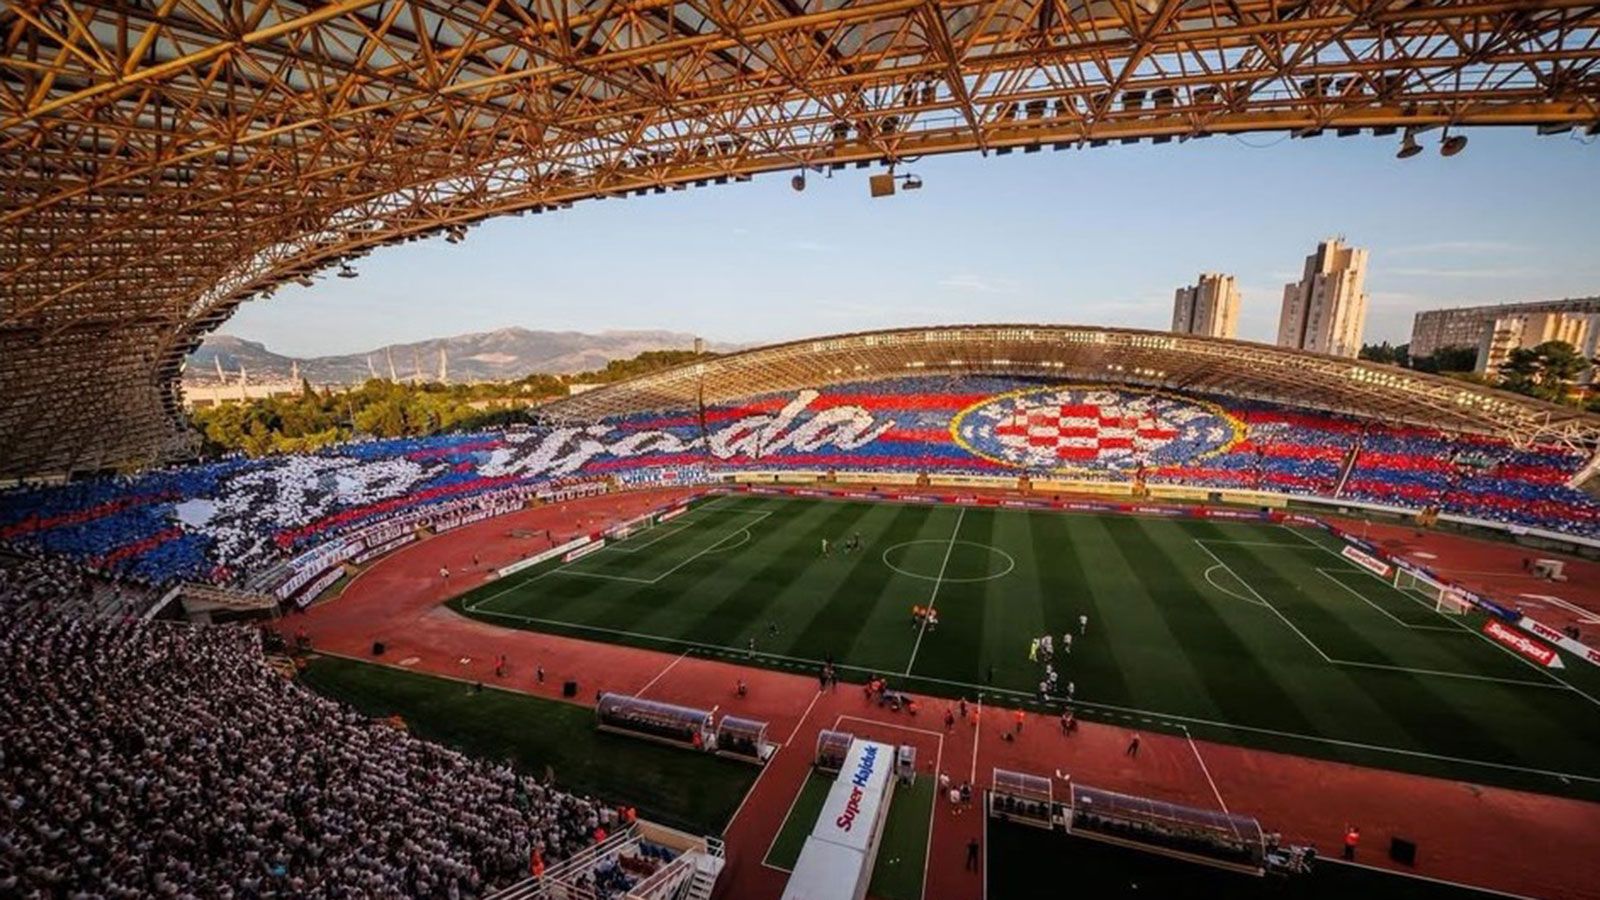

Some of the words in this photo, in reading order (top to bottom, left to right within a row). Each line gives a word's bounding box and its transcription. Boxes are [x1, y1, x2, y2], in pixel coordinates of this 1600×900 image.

[1490, 622, 1551, 660] SuperSport
[836, 786, 863, 832] Super
[852, 745, 878, 787] Hajduk
